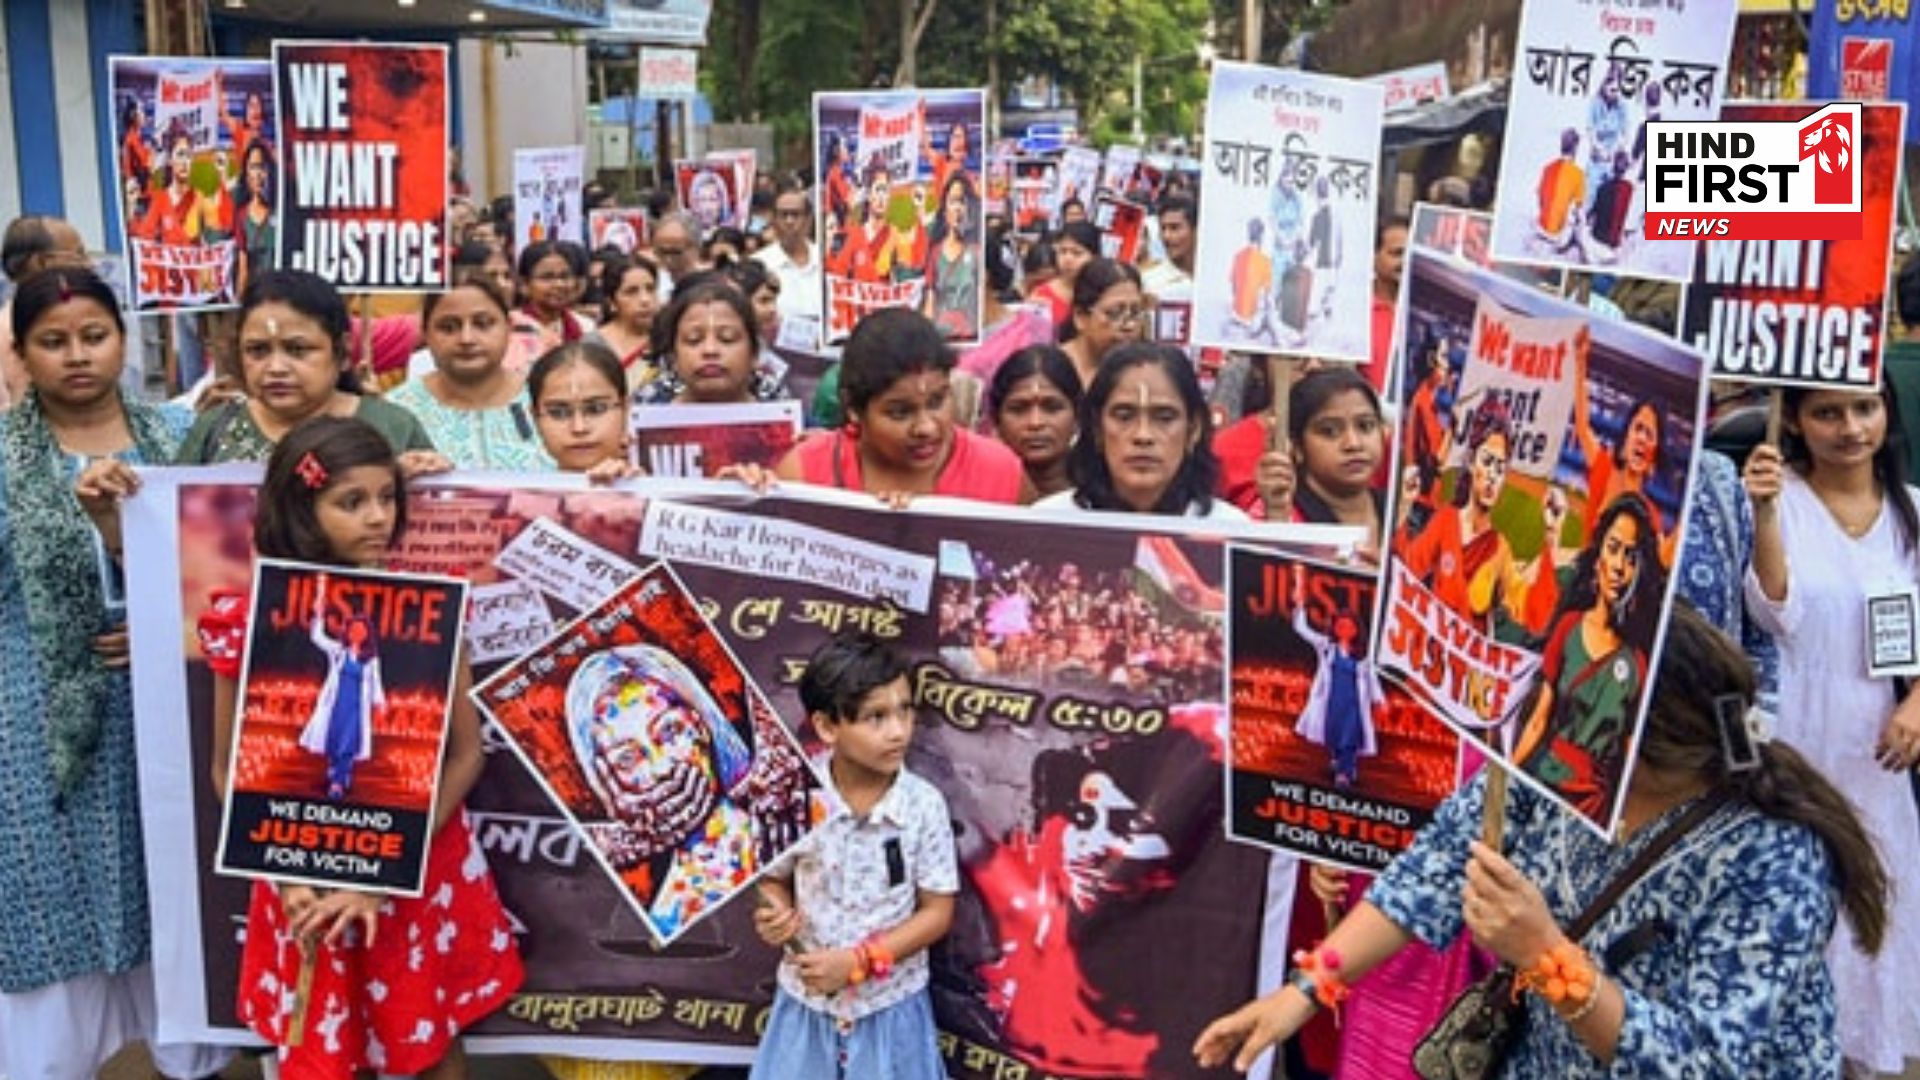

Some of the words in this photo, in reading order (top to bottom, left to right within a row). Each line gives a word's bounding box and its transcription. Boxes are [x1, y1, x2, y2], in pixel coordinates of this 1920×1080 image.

[289, 64, 349, 130] WE
[1526, 46, 1596, 98] আর
[1606, 35, 1652, 101] জি
[1663, 60, 1718, 109] কর
[295, 141, 398, 209] WANT
[1212, 140, 1272, 187] আর
[1282, 130, 1321, 190] জি
[1328, 155, 1372, 199] কর
[292, 220, 443, 285] JUSTICE
[1478, 314, 1510, 367] We
[1511, 340, 1567, 382] want
[1695, 301, 1873, 383] JUSTICE
[270, 573, 447, 644] JUSTICE
[914, 665, 1034, 727] বিকেল
[1052, 700, 1164, 735] ৫:৩০
[267, 800, 300, 819] WE
[303, 803, 393, 831] DEMAND
[1270, 780, 1305, 803] WE
[1310, 789, 1411, 825] DEMAND
[1275, 822, 1322, 847] FOR
[249, 819, 405, 858] JUSTICE
[264, 846, 309, 869] FOR
[313, 851, 382, 876] VICTIM
[508, 988, 669, 1034] বালুরঘাট
[673, 998, 749, 1034] থানা
